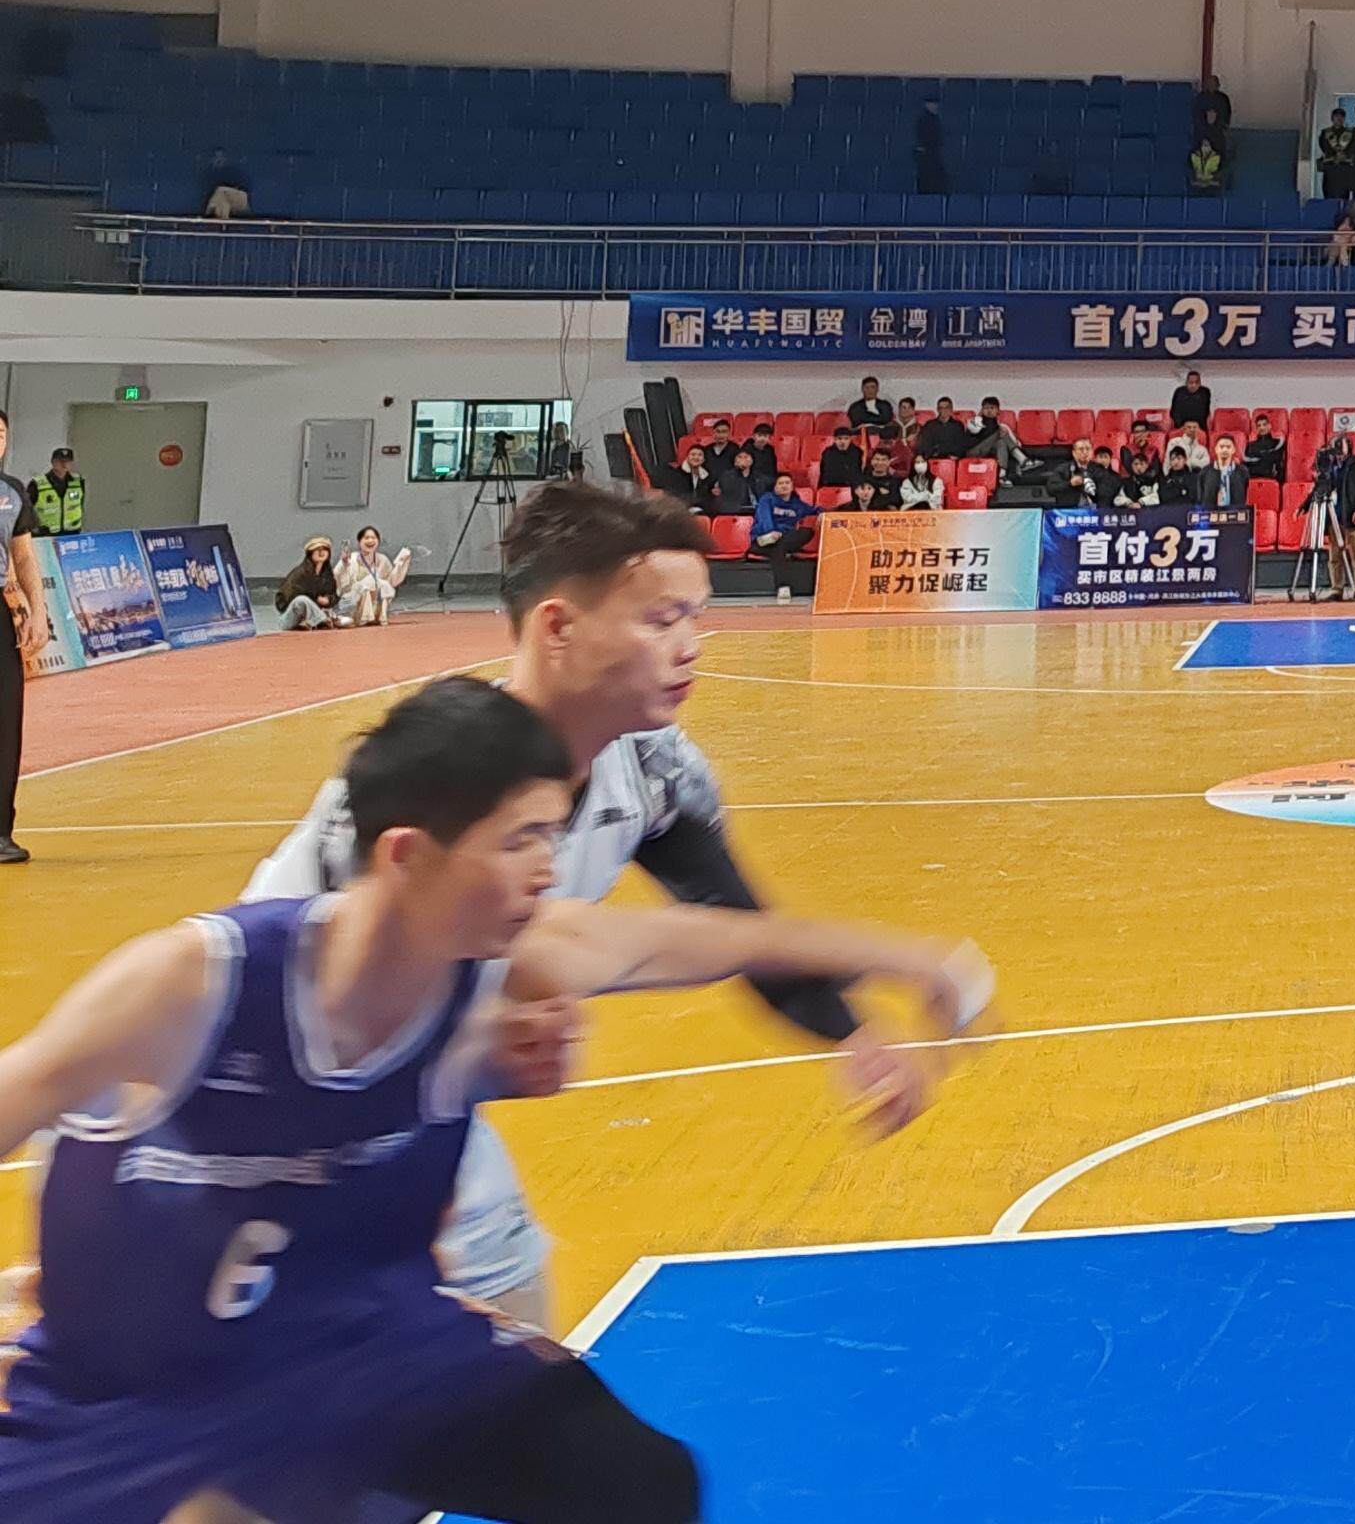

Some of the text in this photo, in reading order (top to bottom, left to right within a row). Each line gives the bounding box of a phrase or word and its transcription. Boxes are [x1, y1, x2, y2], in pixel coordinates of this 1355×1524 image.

[712, 307, 844, 337] 华丰国贸
[869, 307, 928, 339] 金湾
[1070, 297, 1262, 357] 首付3万
[870, 548, 990, 569] 助力百千万
[1077, 526, 1220, 567] 首付3万
[868, 573, 988, 595] 聚力促崛起
[1077, 567, 1216, 585] 买市区精装江景两房
[1063, 592, 1090, 605] 833
[1092, 591, 1127, 604] 8888
[207, 1221, 292, 1321] 6
